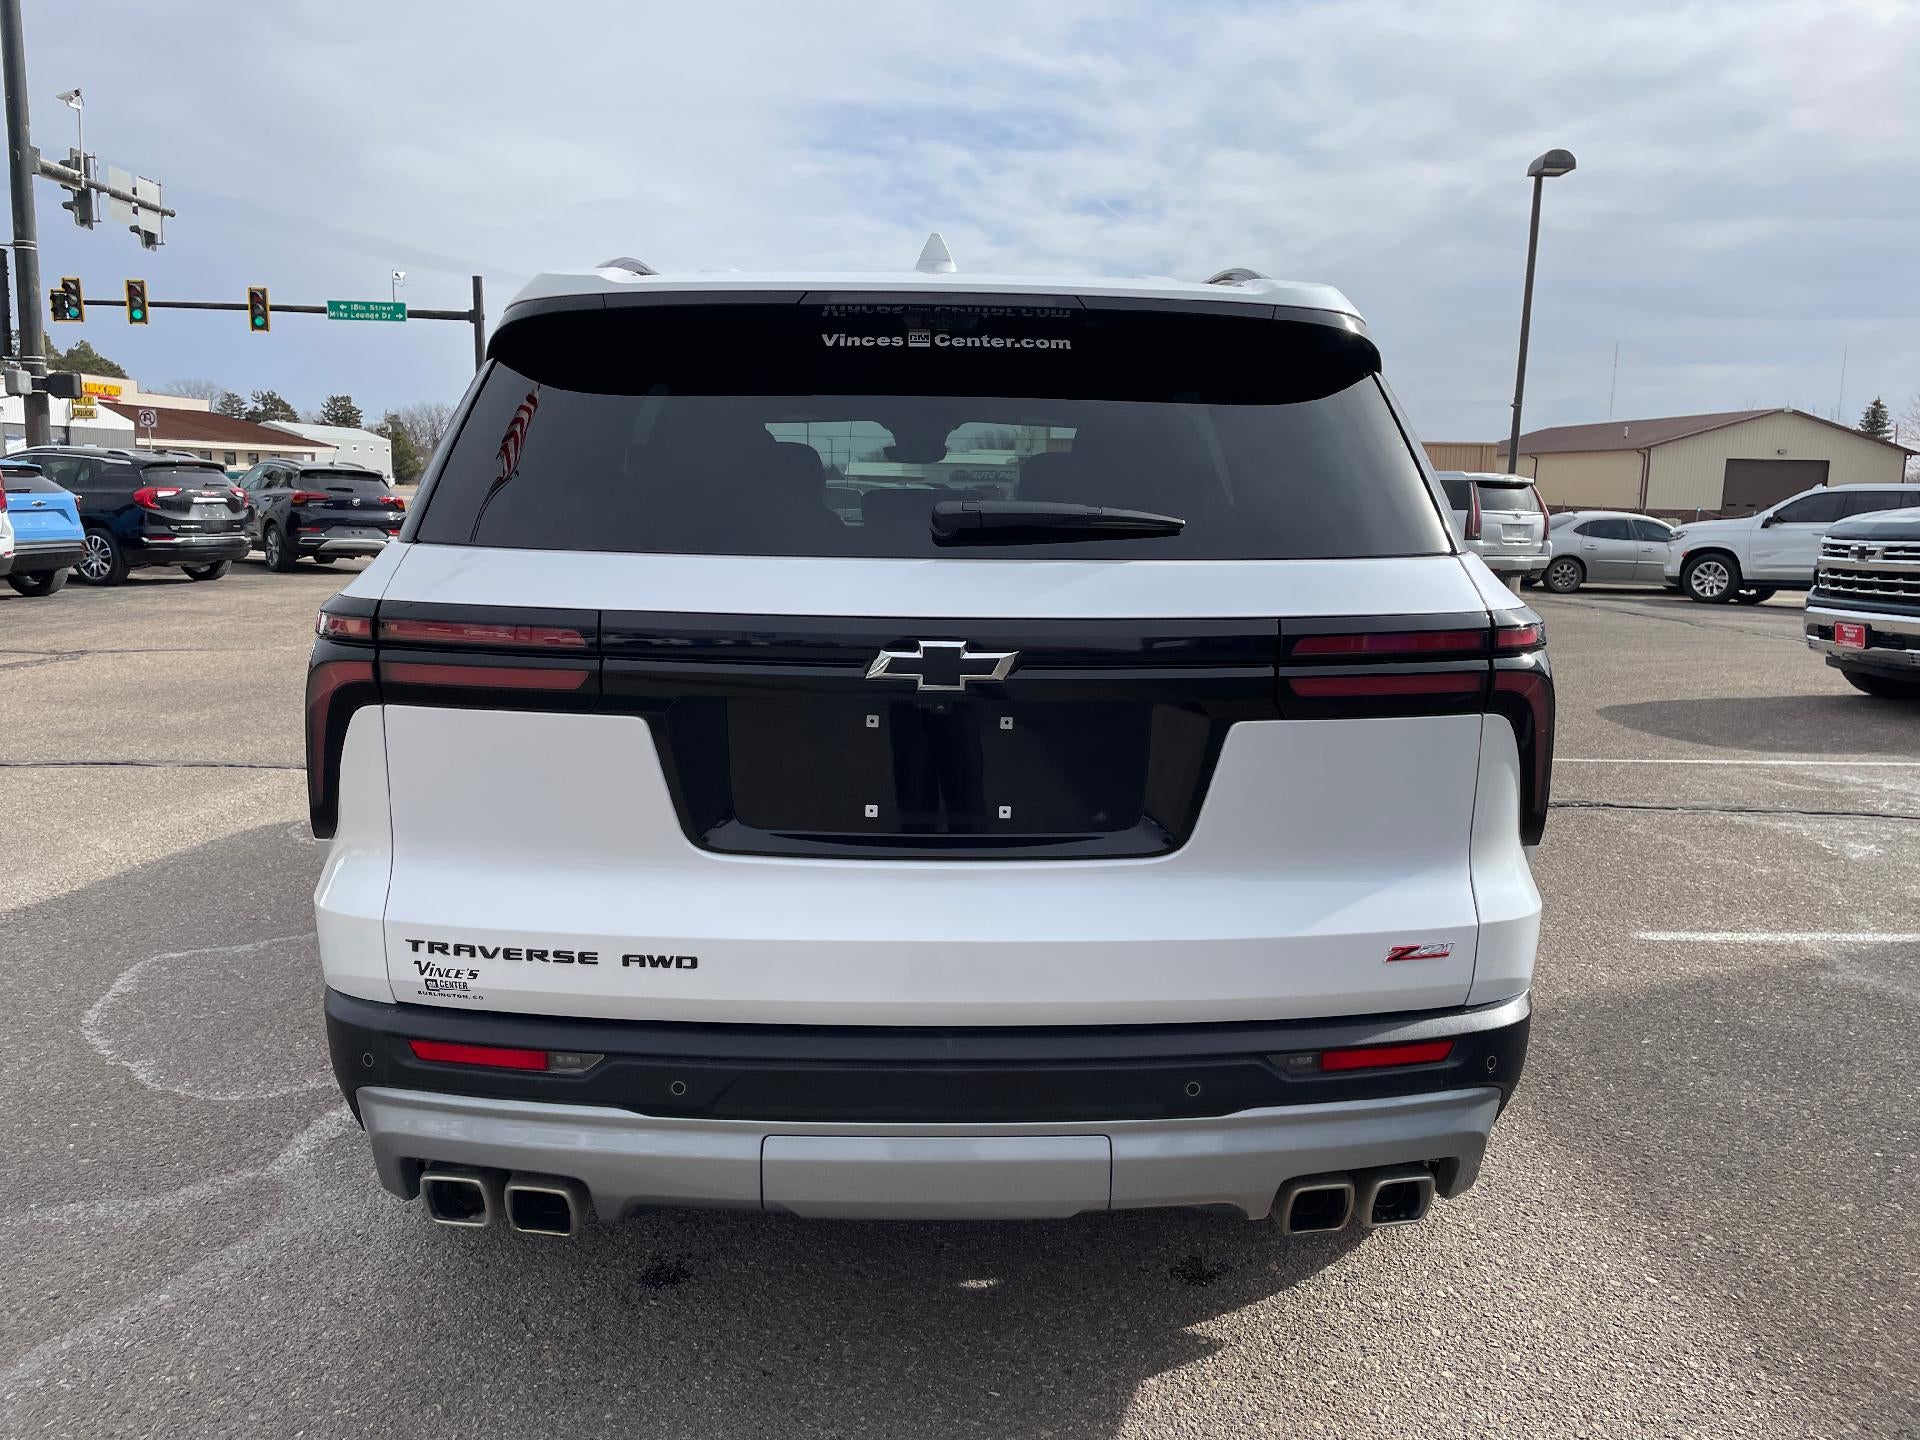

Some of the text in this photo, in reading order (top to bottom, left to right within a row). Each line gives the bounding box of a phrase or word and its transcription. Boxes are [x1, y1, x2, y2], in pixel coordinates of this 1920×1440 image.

[369, 304, 394, 312] Street
[350, 312, 379, 320] Lounge
[821, 333, 904, 347] Vinces
[934, 333, 1072, 350] Center.com
[405, 938, 699, 970] TRAVERSE AWD
[1384, 941, 1456, 962] Z71
[439, 980, 469, 990] CENTER
